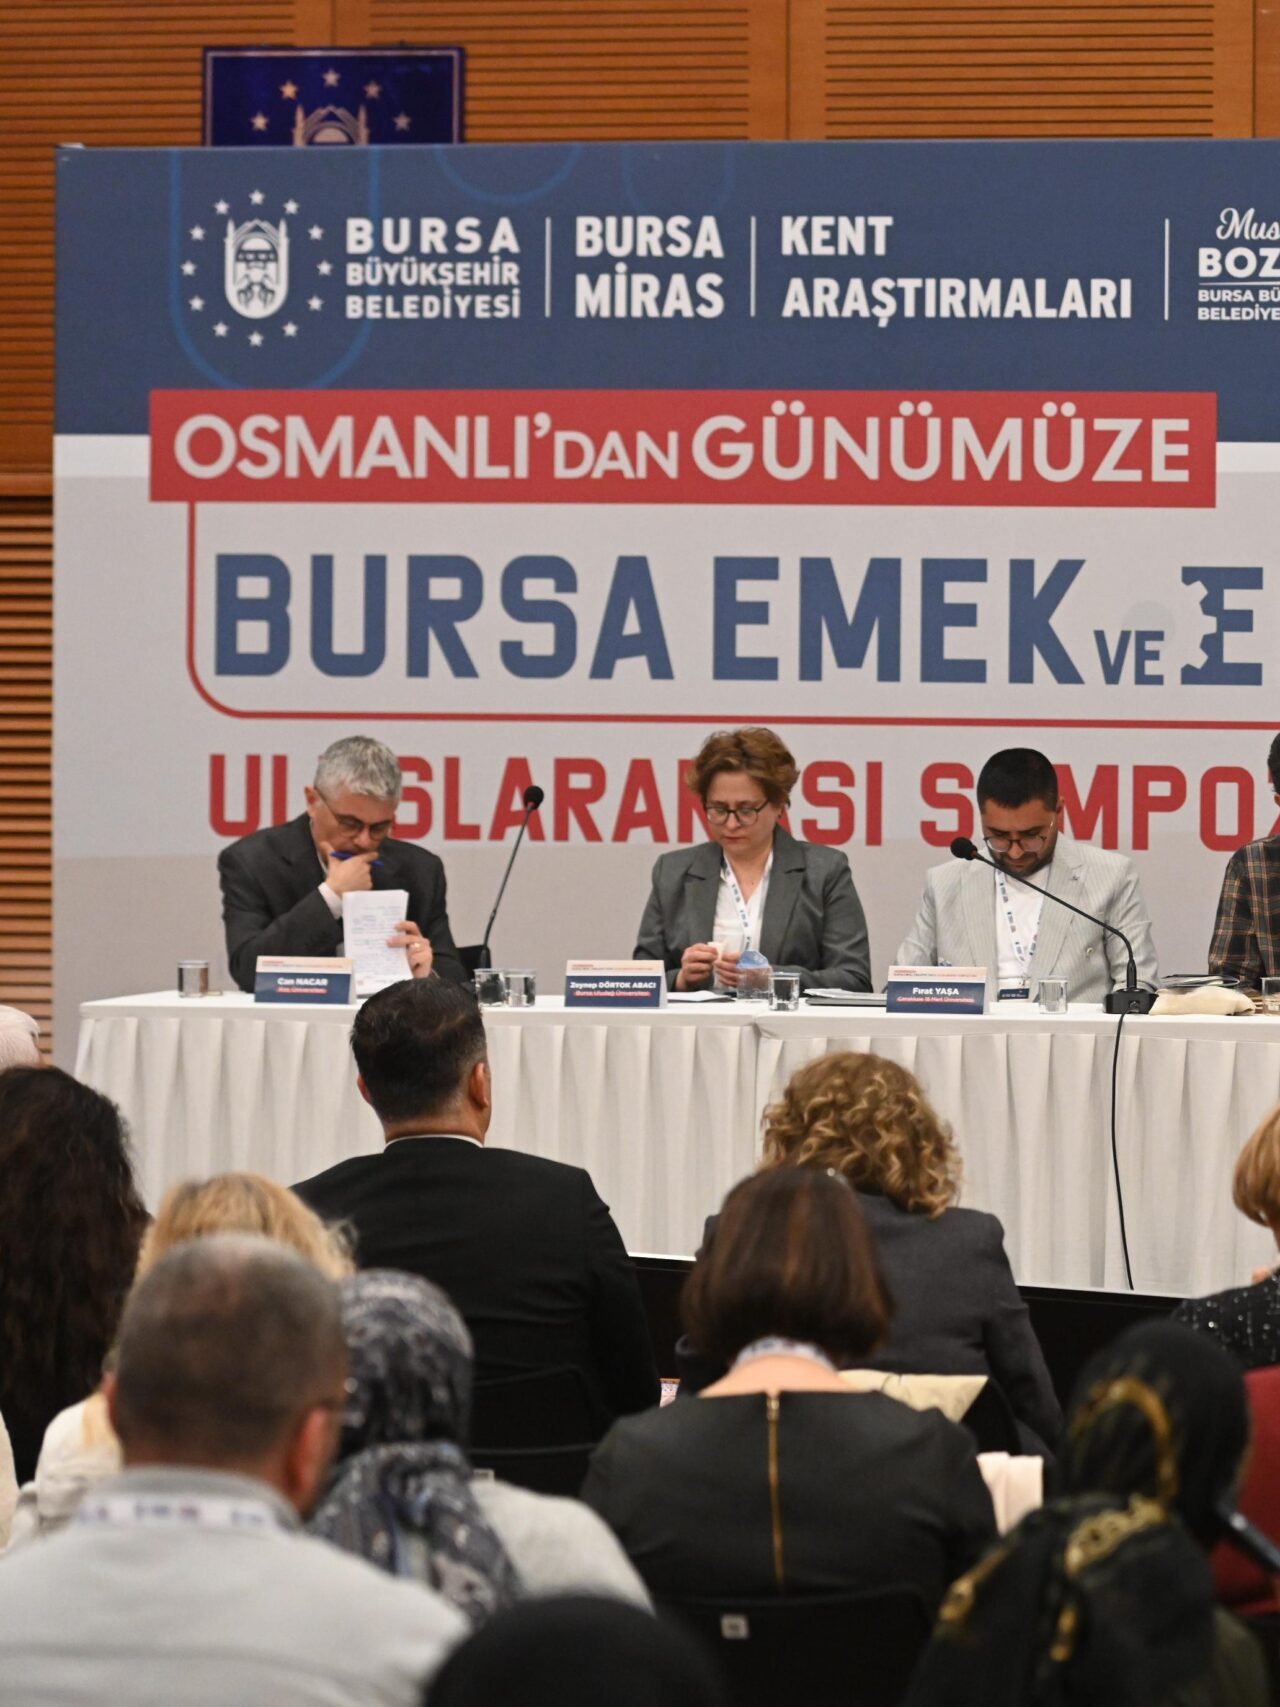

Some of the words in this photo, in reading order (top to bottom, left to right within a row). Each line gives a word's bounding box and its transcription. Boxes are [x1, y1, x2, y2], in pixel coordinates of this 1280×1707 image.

[346, 217, 521, 254] BURSA
[575, 215, 725, 258] BURSA
[781, 216, 893, 256] KENT
[346, 255, 520, 289] BÜYÜKŞEHİR
[575, 261, 725, 319] MİRAS
[346, 288, 520, 319] BELEDİYESİ
[780, 278, 1132, 328] ARAŞTIRMALARI
[1198, 289, 1254, 302] BURSA
[692, 400, 1190, 482] GÜNÜMÜZE
[215, 553, 675, 680] BURSA
[712, 555, 1086, 685] EMEK
[1092, 629, 1165, 686] VE
[912, 987, 933, 995] Fırat
[935, 987, 960, 997] YAŞA
